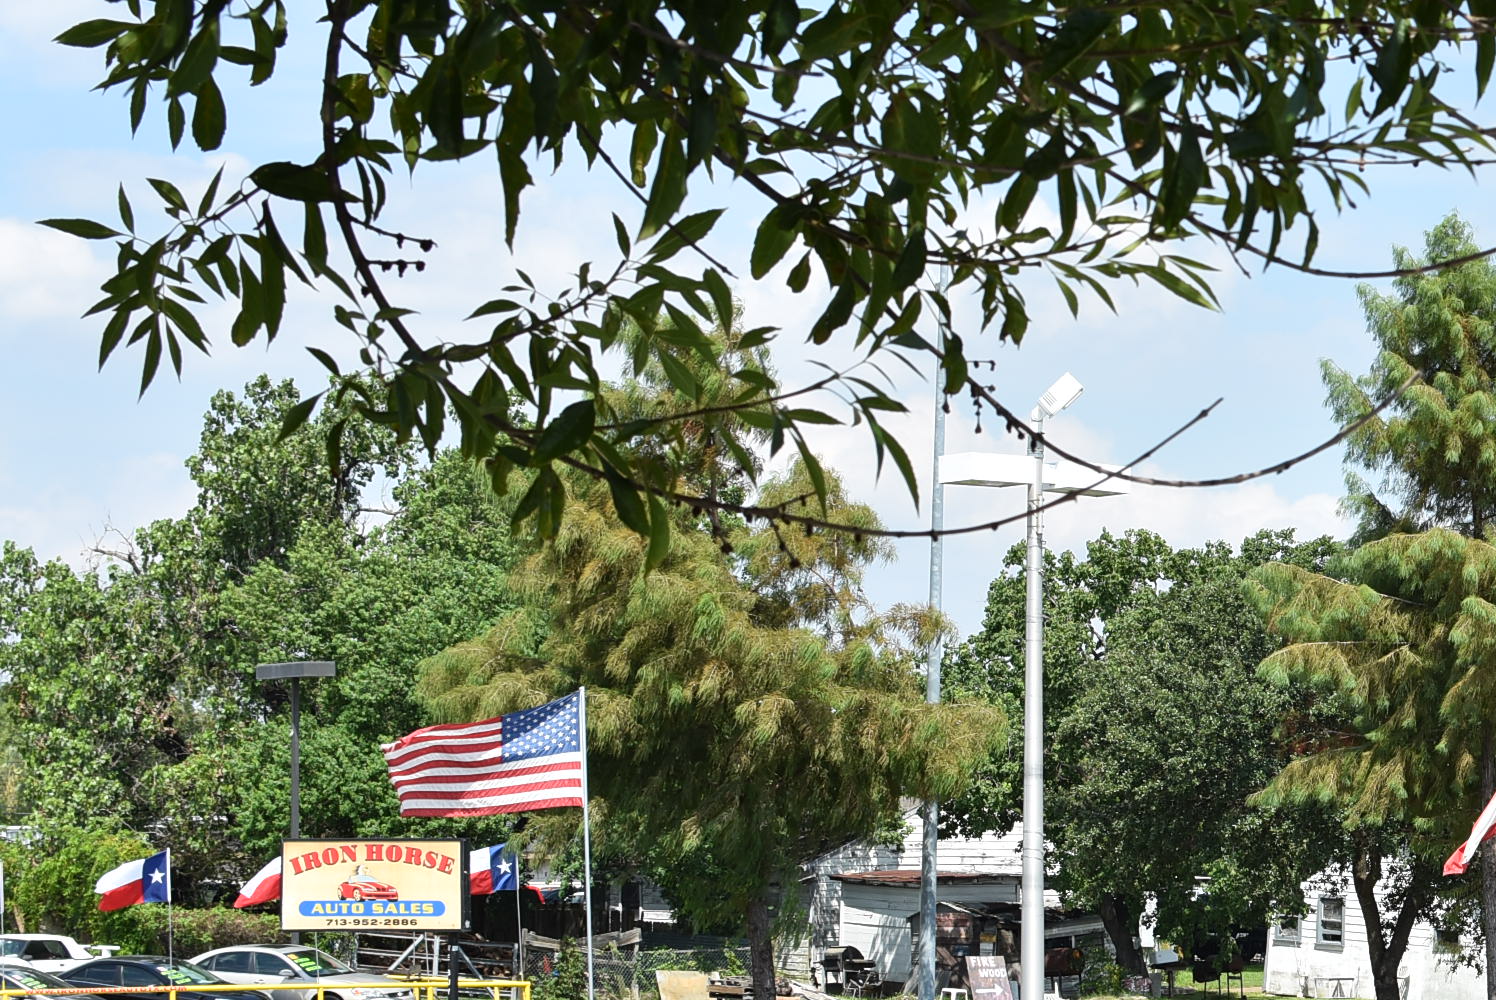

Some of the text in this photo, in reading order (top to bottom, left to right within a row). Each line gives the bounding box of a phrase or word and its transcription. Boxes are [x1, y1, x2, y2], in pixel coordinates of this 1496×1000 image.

[289, 844, 456, 875] IRON HORSE
[311, 902, 435, 914] AUTO SALES
[970, 956, 996, 968] FIRE
[978, 967, 1008, 978] WOOD
